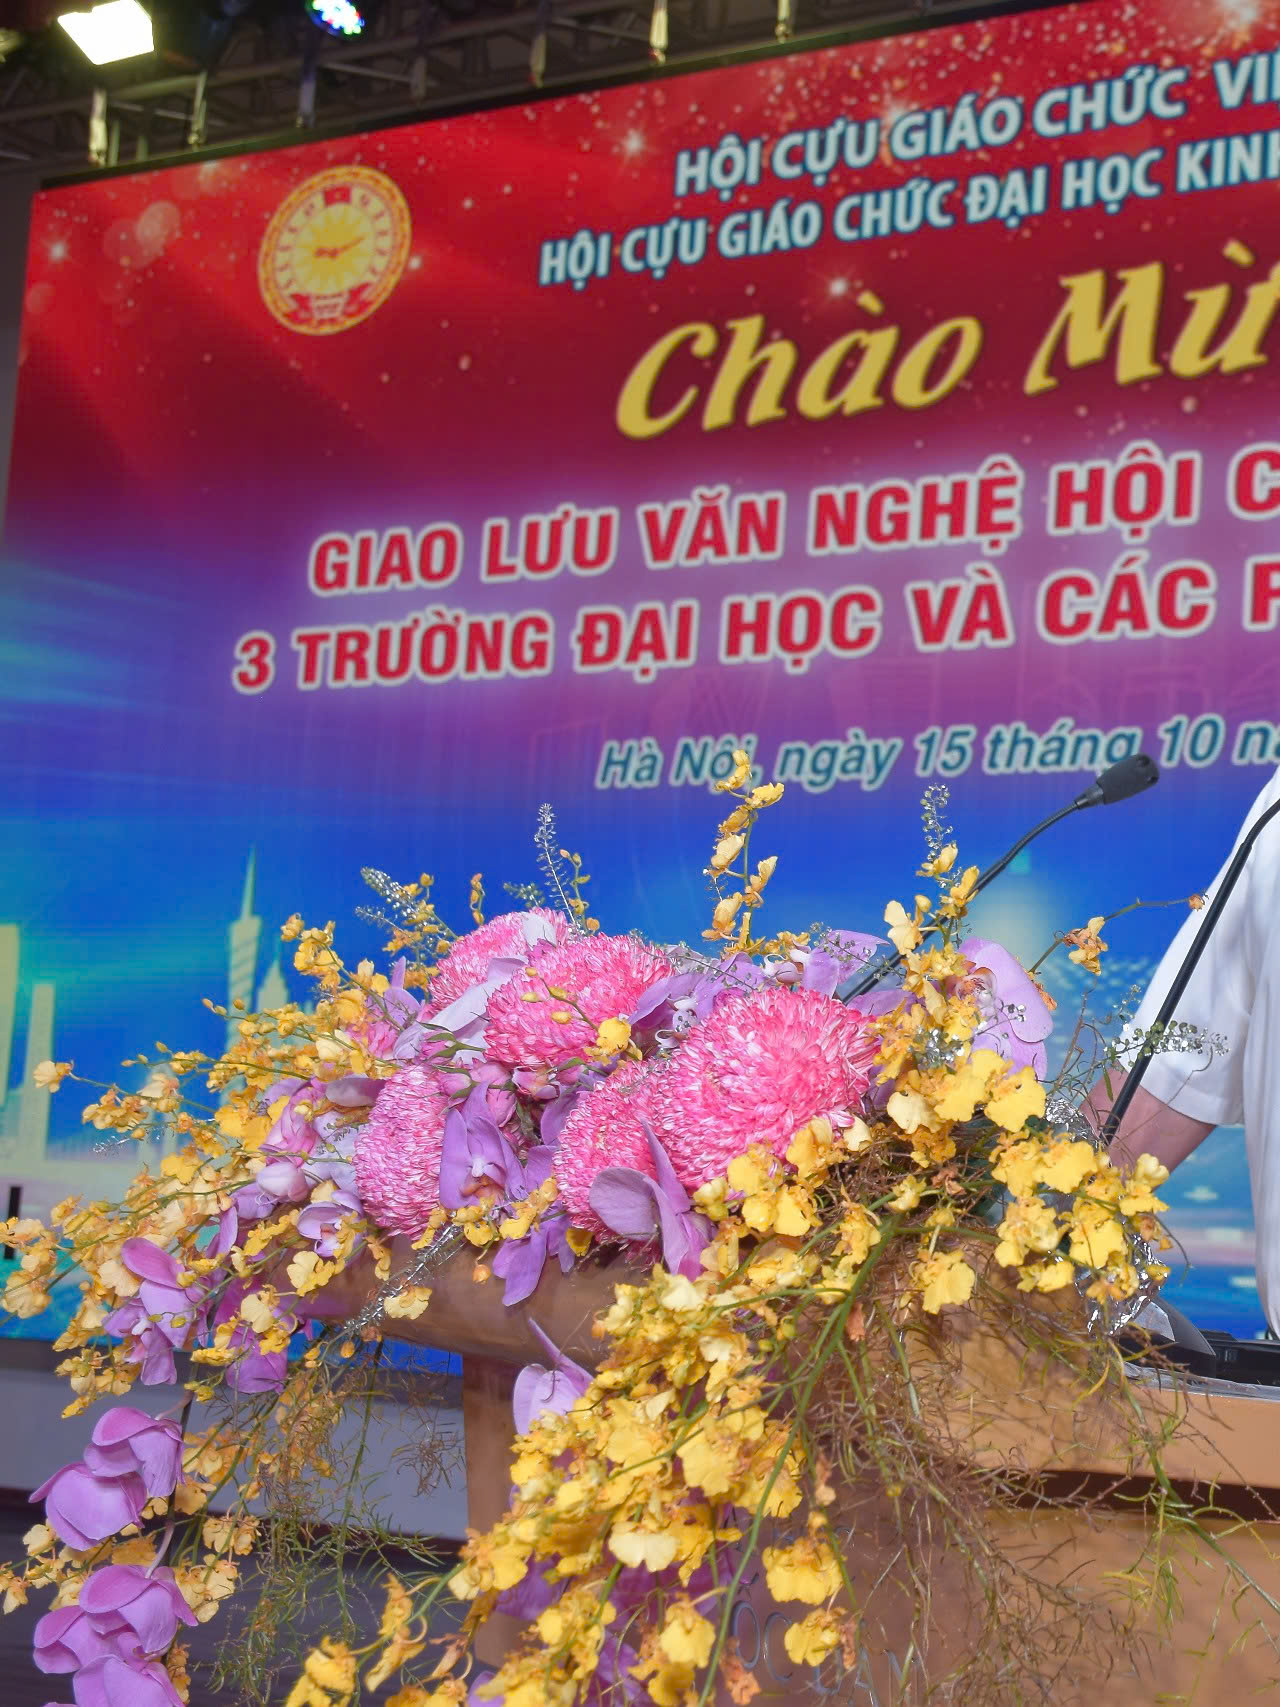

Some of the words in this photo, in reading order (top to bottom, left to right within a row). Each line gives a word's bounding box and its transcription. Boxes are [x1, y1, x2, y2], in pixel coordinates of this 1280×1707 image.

[675, 133, 761, 200] HỘI
[771, 116, 880, 186] CỰU
[889, 95, 1023, 161] GIÁO
[1032, 64, 1188, 139] CHỨC
[540, 231, 610, 290] HỘI
[620, 214, 706, 280] CỰU
[717, 200, 822, 260] GIÁO
[834, 171, 956, 240] CHỨC
[965, 168, 1046, 229] ĐẠI
[1061, 150, 1162, 214] HỌC
[616, 292, 982, 439] Chào
[311, 527, 461, 594] GIAO
[484, 506, 618, 580] LƯU
[641, 489, 783, 567] VĂN
[812, 457, 1023, 551] NGHỆ
[1053, 445, 1196, 539] HỘI
[235, 635, 273, 690] 3
[296, 610, 551, 685] TRƯỜNG
[575, 604, 694, 679] ĐẠI
[724, 591, 879, 672] HỌC
[911, 570, 1010, 646] VÀ
[1042, 557, 1213, 638] CÁC
[599, 740, 660, 785] Hà
[778, 727, 899, 788] ngày
[915, 727, 968, 774] 15
[1162, 715, 1224, 765] 10
